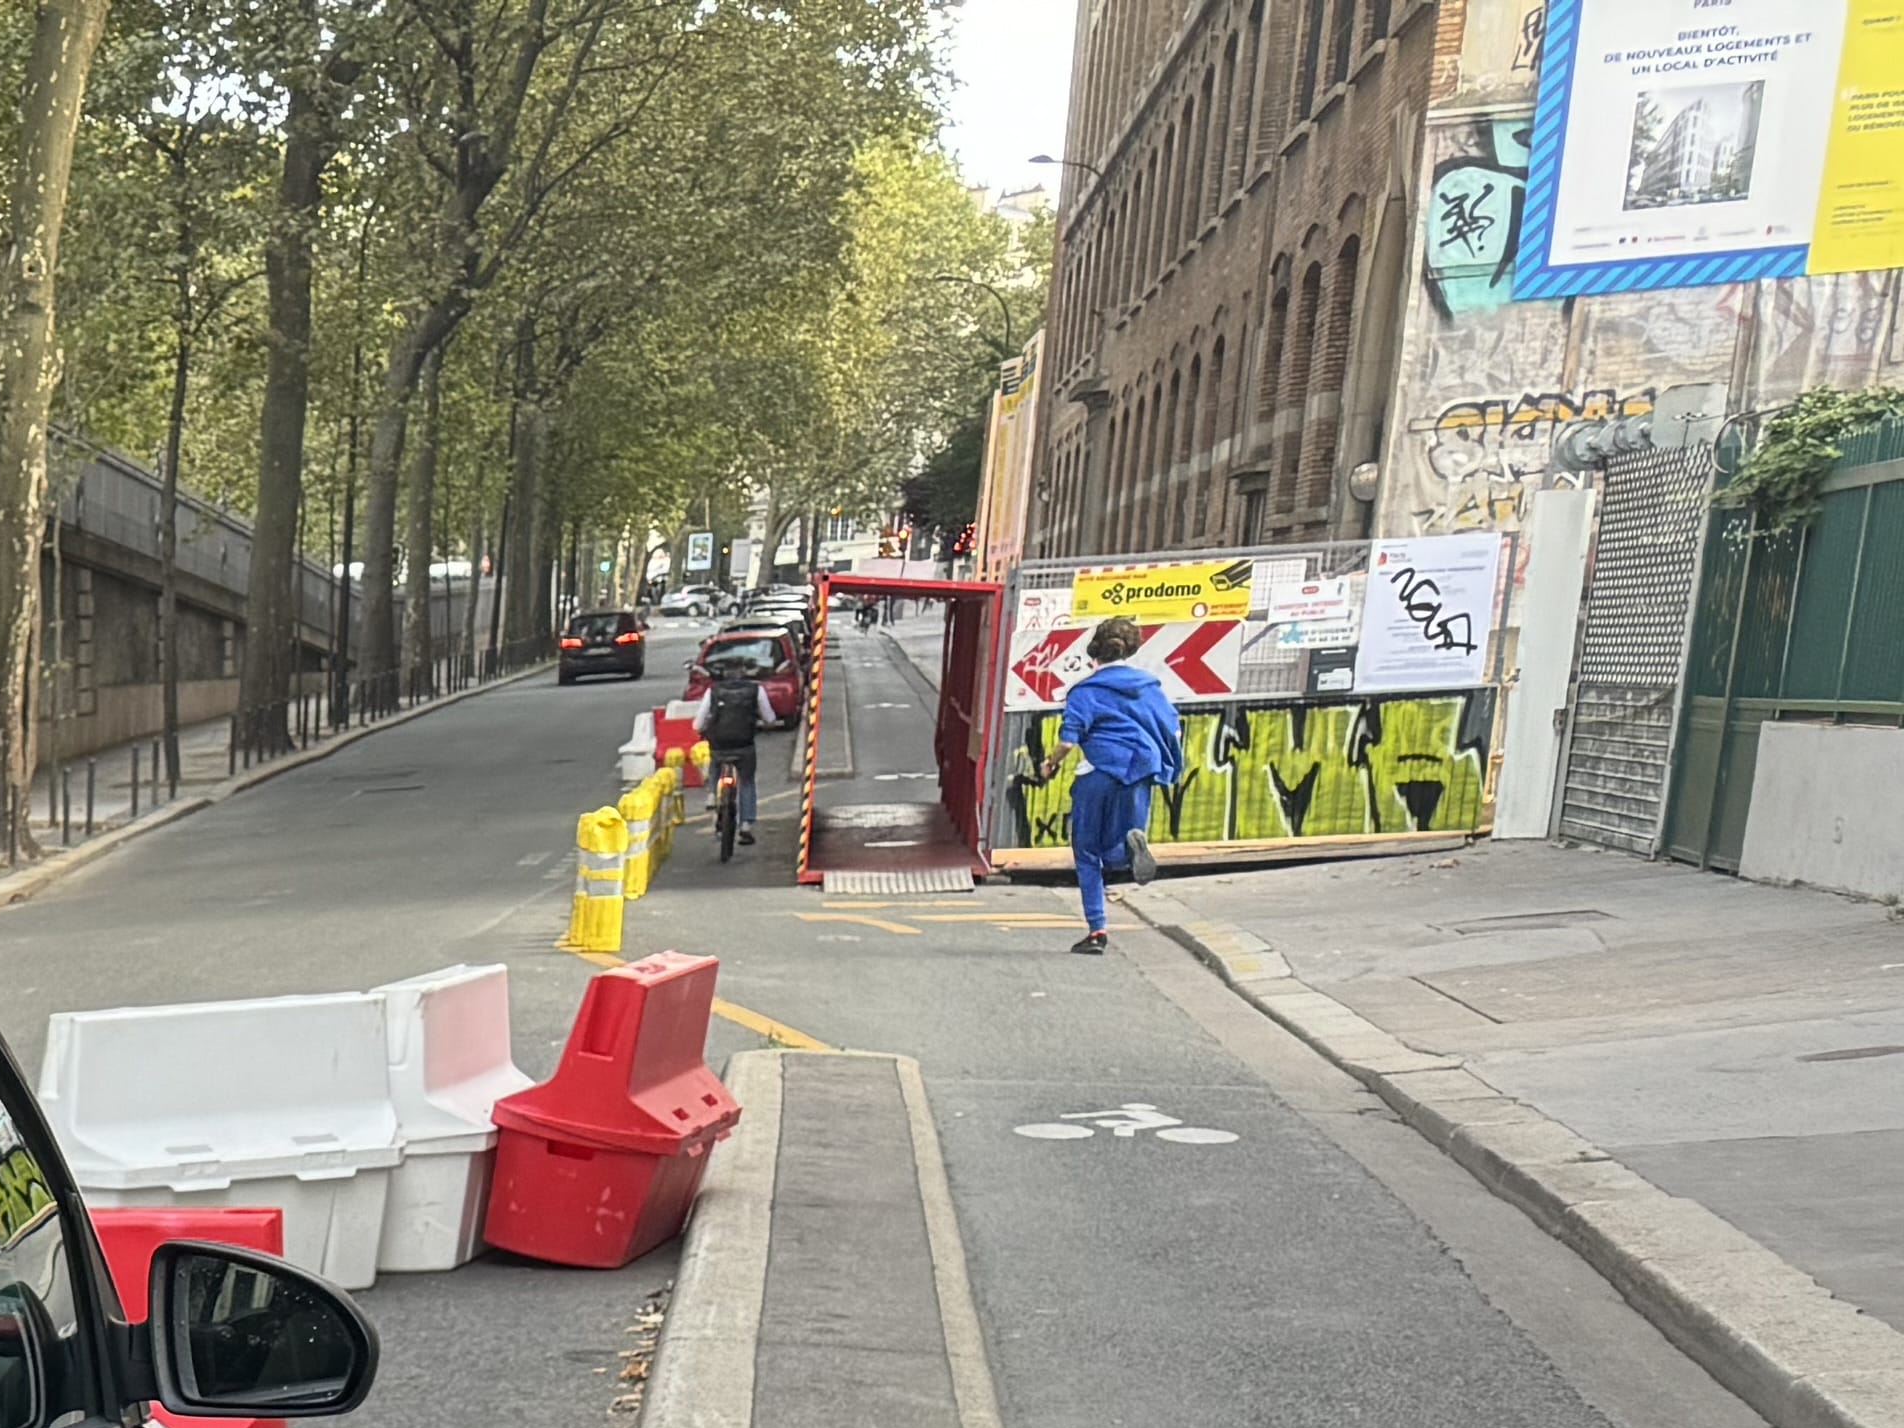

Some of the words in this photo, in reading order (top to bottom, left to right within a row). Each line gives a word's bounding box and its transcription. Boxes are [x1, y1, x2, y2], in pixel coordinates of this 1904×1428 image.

[1603, 52, 1622, 64] DE
[1626, 45, 1702, 61] NOUVEAUX
[1706, 34, 1791, 53] LOGEMENTS
[1794, 32, 1813, 44] ET
[1631, 64, 1651, 75] UN
[1655, 60, 1699, 73] LOCAL
[1126, 583, 1202, 603] prodomo
